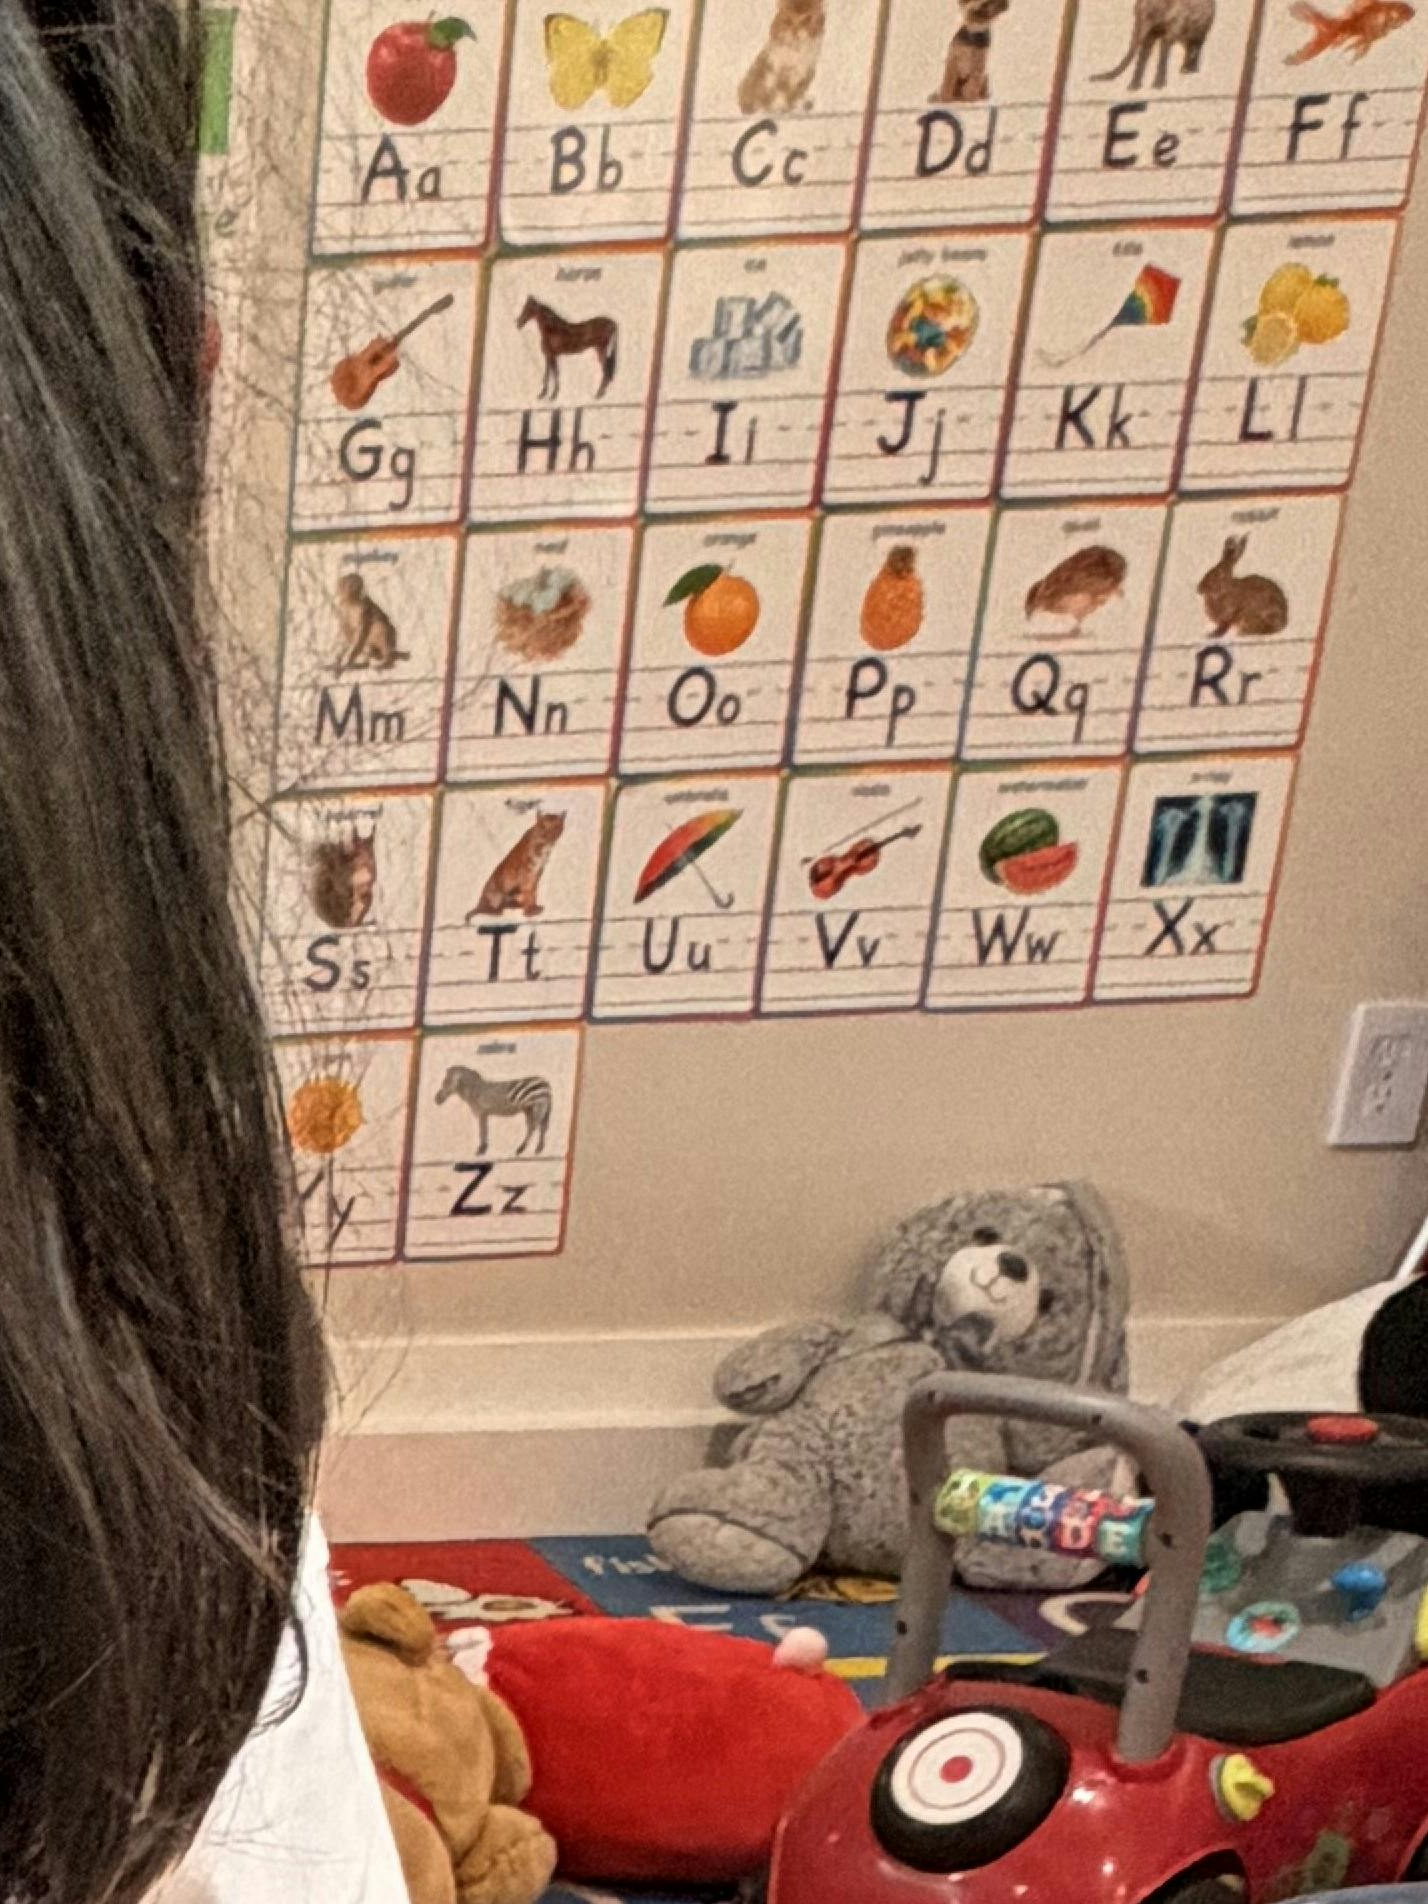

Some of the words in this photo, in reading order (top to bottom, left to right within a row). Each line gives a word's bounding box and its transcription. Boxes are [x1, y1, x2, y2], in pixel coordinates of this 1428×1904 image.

[361, 133, 443, 203] Aa
[550, 125, 624, 195] Bb
[732, 119, 811, 186] Cc
[915, 106, 998, 178] Dd
[1103, 103, 1181, 169] Ee
[1287, 93, 1370, 162] Ff
[339, 418, 416, 512] Gg
[517, 408, 596, 474] Hh
[705, 401, 759, 465] Ii
[877, 391, 945, 486] Jj
[1055, 386, 1137, 449] Kk
[314, 685, 406, 745] Mm
[493, 677, 569, 737] Nn
[667, 666, 741, 726] Oo
[845, 656, 917, 747] Pp
[1010, 654, 1089, 745] Qq
[1190, 645, 1264, 707] Rr
[303, 936, 372, 993] Ss
[477, 925, 543, 982] Tt
[642, 918, 711, 975] Uu
[816, 912, 883, 969] Vv
[972, 907, 1059, 967] Ww
[1144, 899, 1227, 956] Xx
[449, 1162, 529, 1217] Zz
